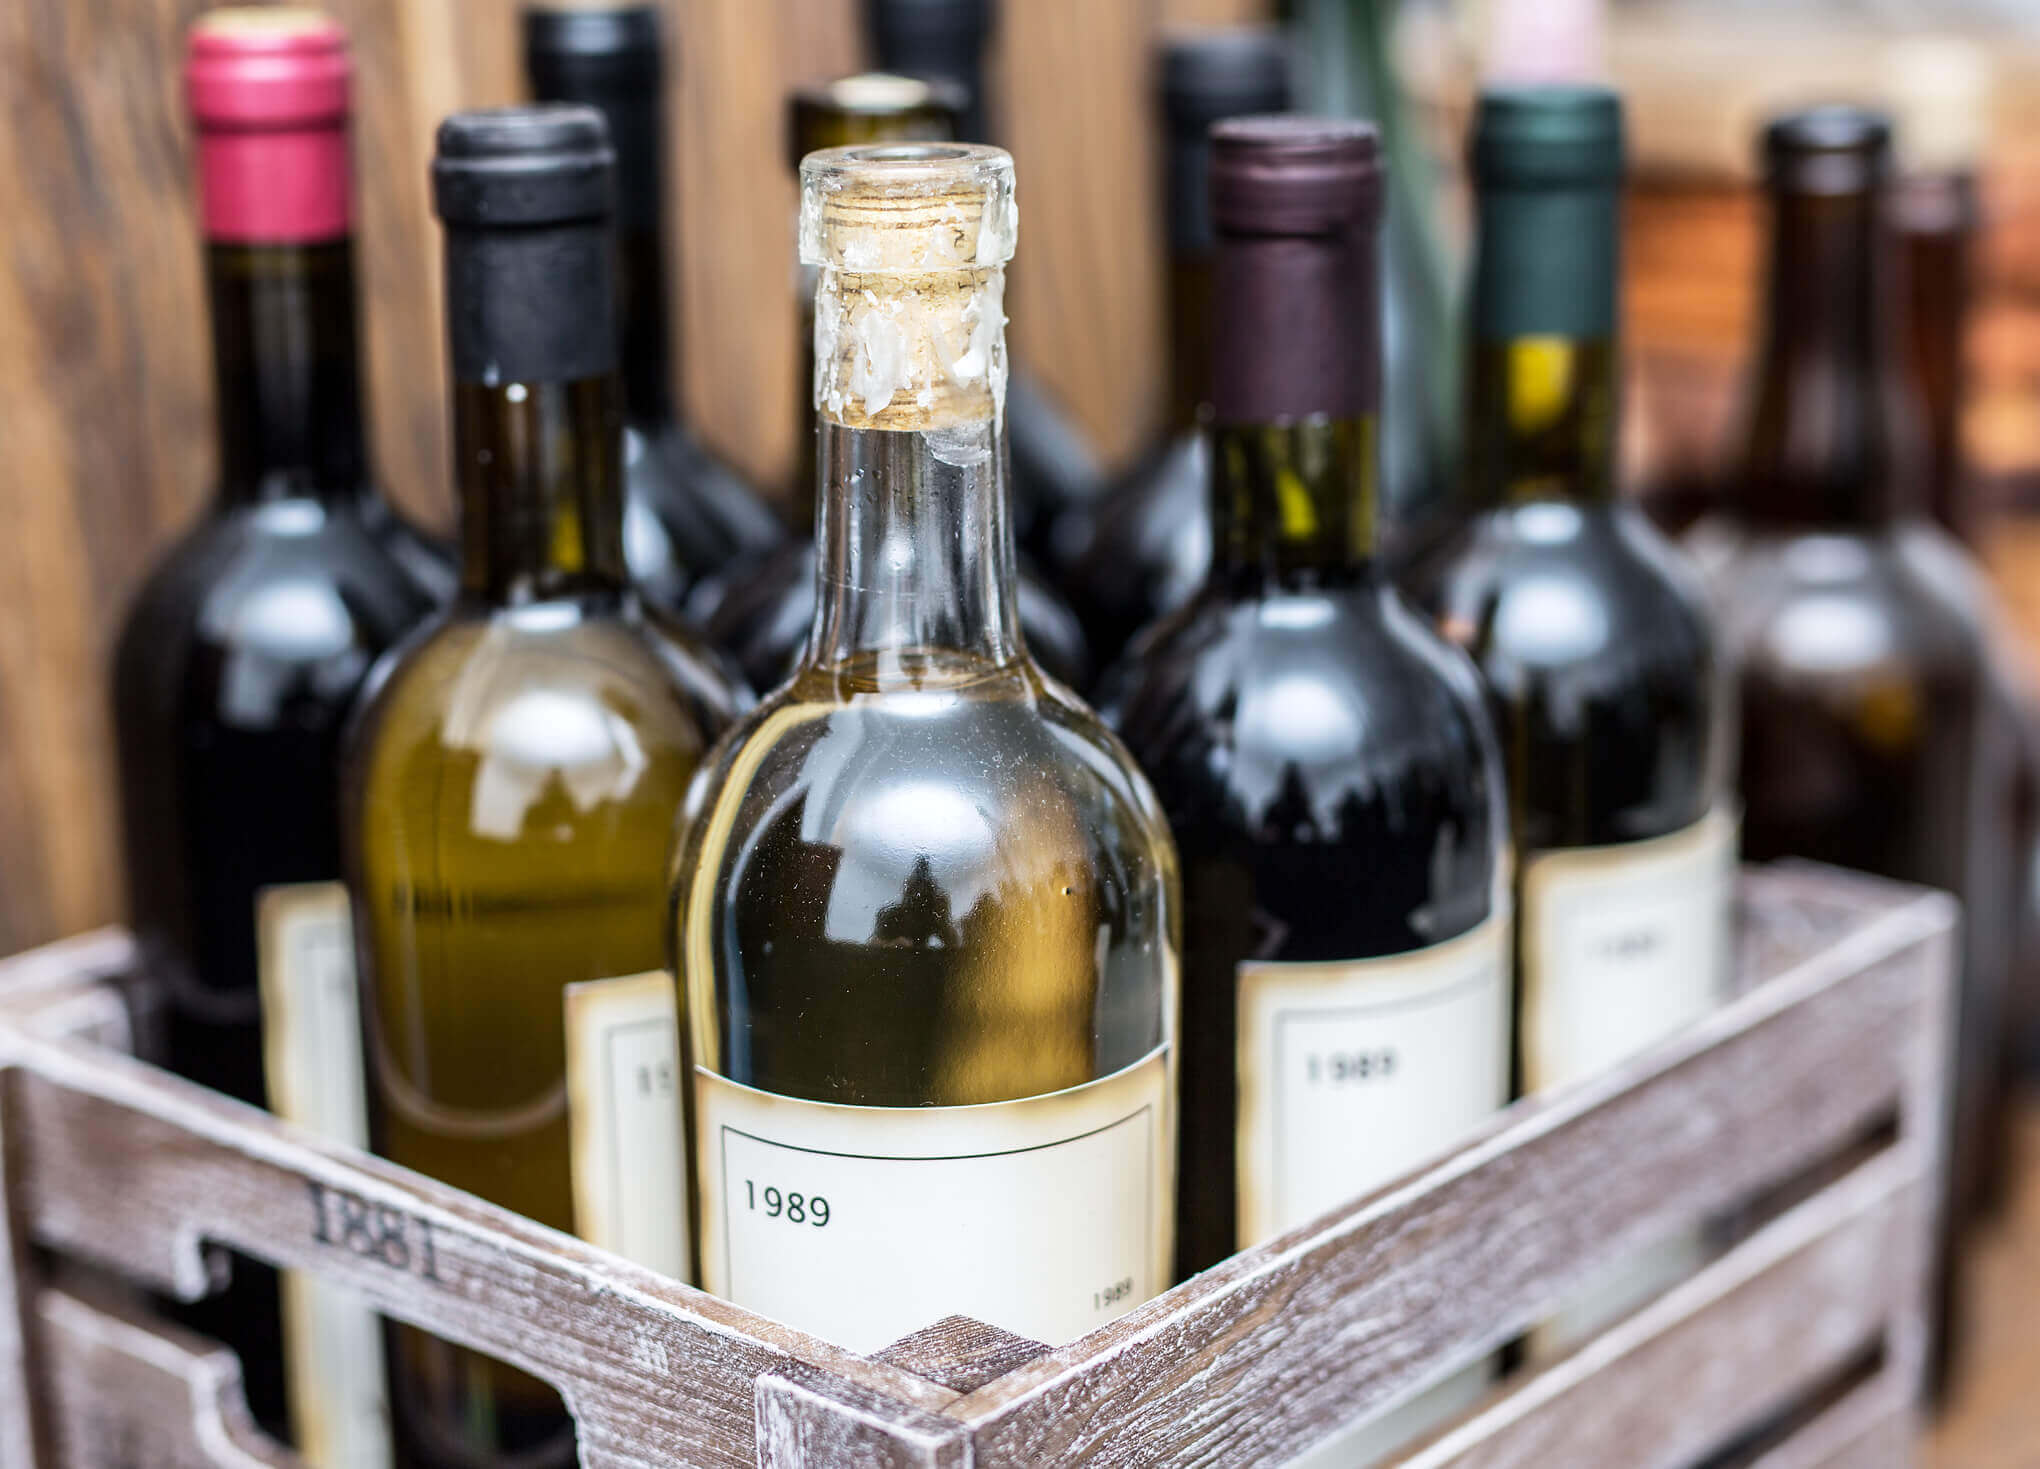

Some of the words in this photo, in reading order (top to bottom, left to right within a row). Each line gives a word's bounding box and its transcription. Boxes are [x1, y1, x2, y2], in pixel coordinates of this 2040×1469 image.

[744, 1178, 830, 1227] 1989
[306, 1181, 445, 1283] 1881
[1093, 1277, 1132, 1311] 1989
